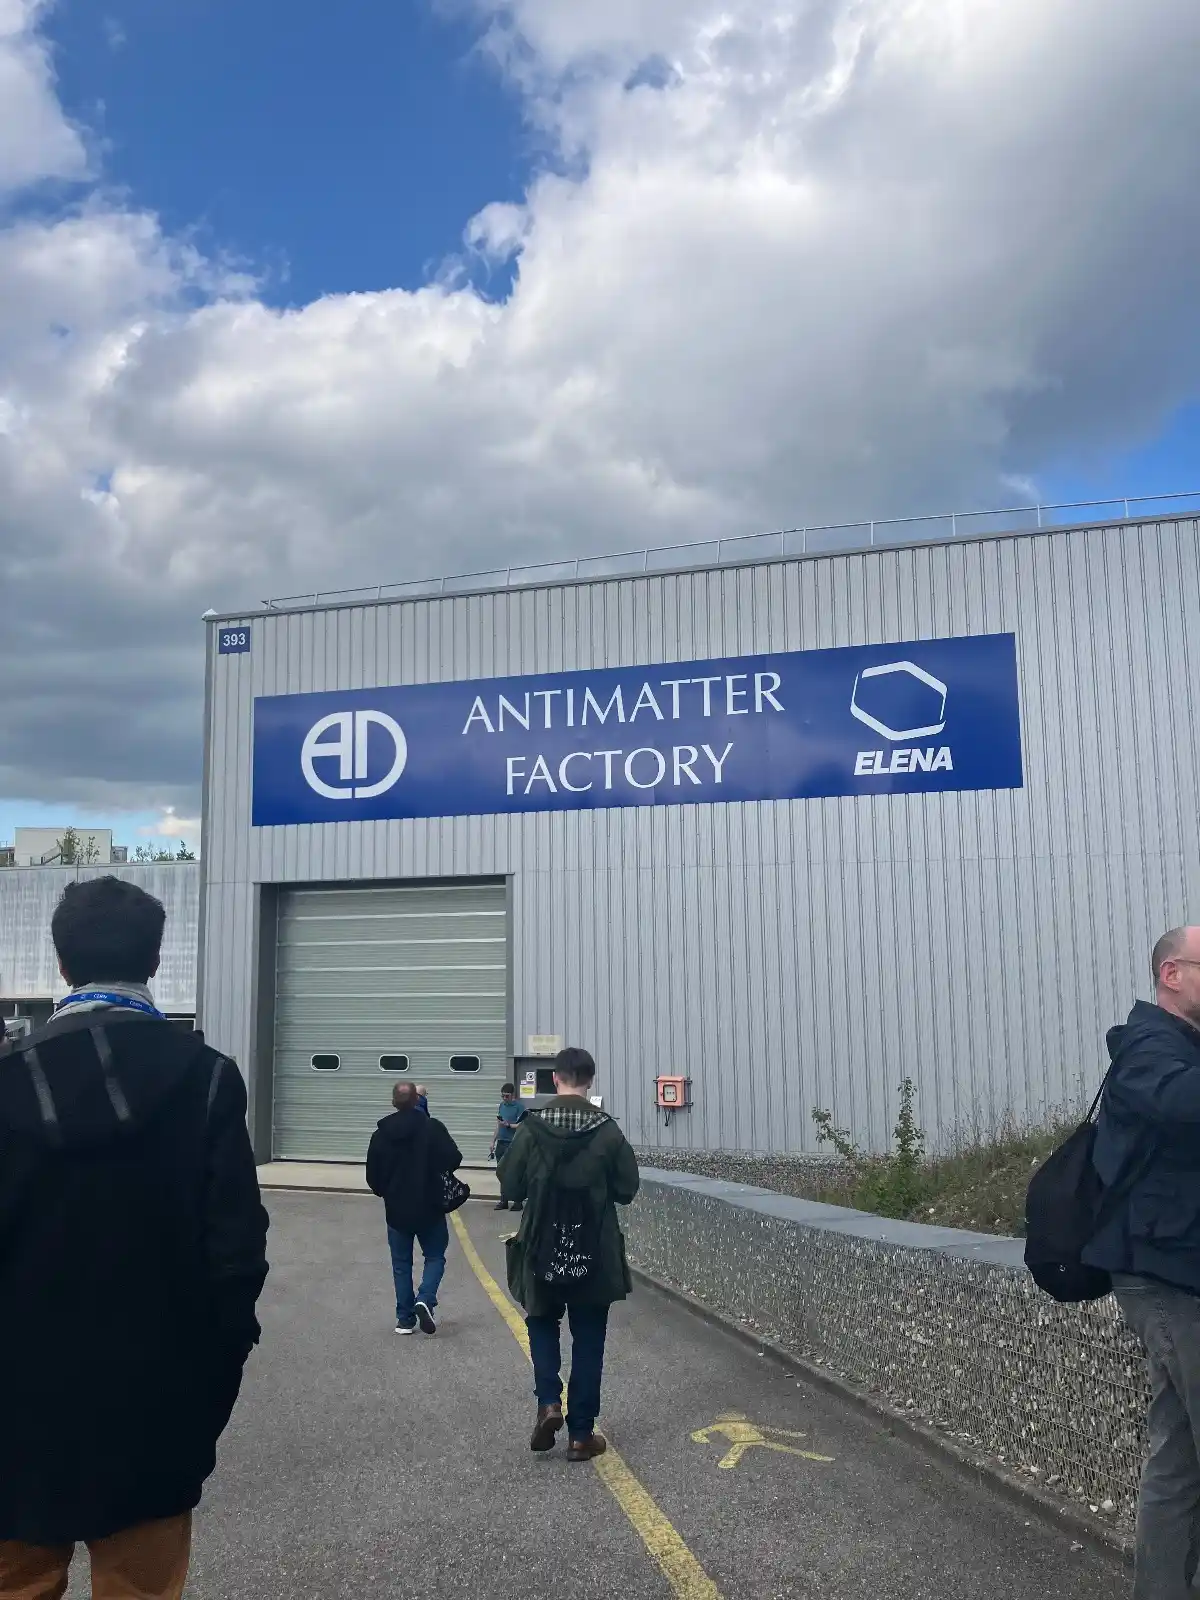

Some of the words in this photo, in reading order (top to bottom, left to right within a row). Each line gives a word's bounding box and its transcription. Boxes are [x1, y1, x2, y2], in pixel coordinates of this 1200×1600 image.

[223, 633, 246, 646] 393
[462, 672, 785, 734] ANTIMATTER
[506, 742, 733, 795] FACTORY
[853, 747, 954, 775] ELENA
